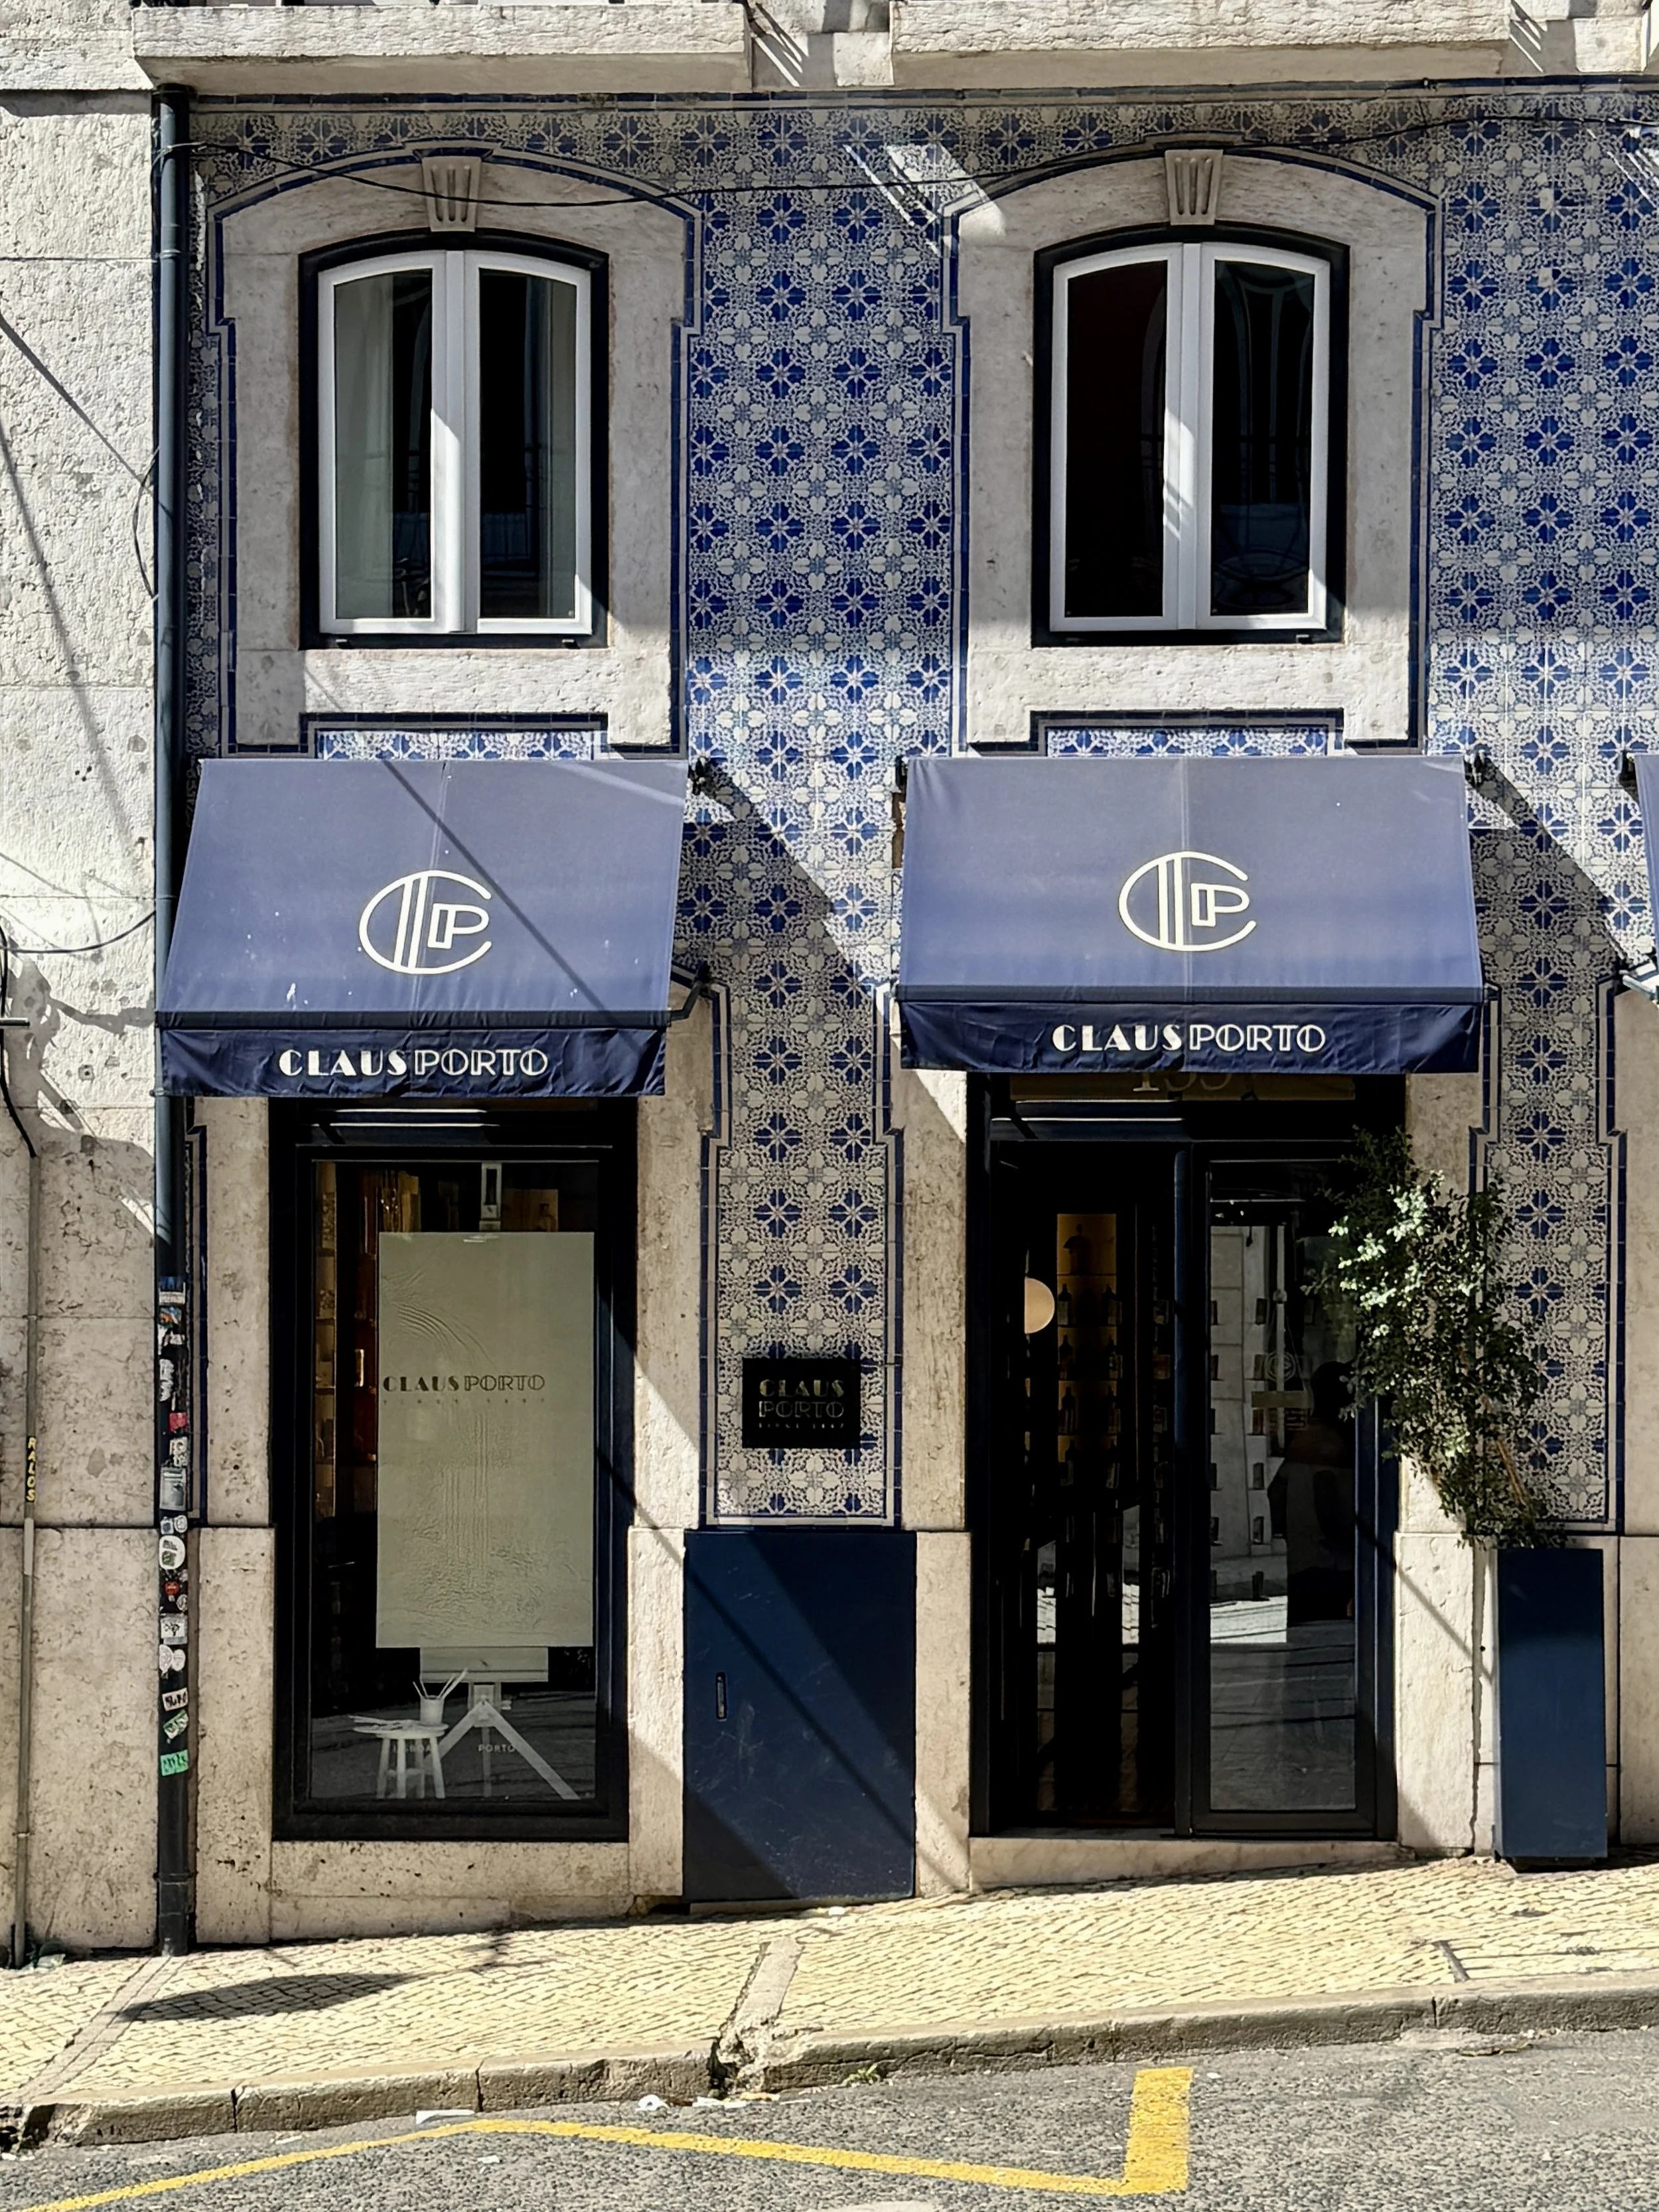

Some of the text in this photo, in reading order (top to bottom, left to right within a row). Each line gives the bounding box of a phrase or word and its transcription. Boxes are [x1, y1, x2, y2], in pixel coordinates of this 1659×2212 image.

[1052, 1023, 1326, 1053] CLAUS PORTO
[278, 1049, 549, 1077] CLAUS PORTO
[383, 1374, 545, 1392] CLAUS PORTO
[758, 1379, 845, 1398] CLAUS
[758, 1400, 845, 1418] PORTO
[478, 1743, 516, 1753] PORTO
